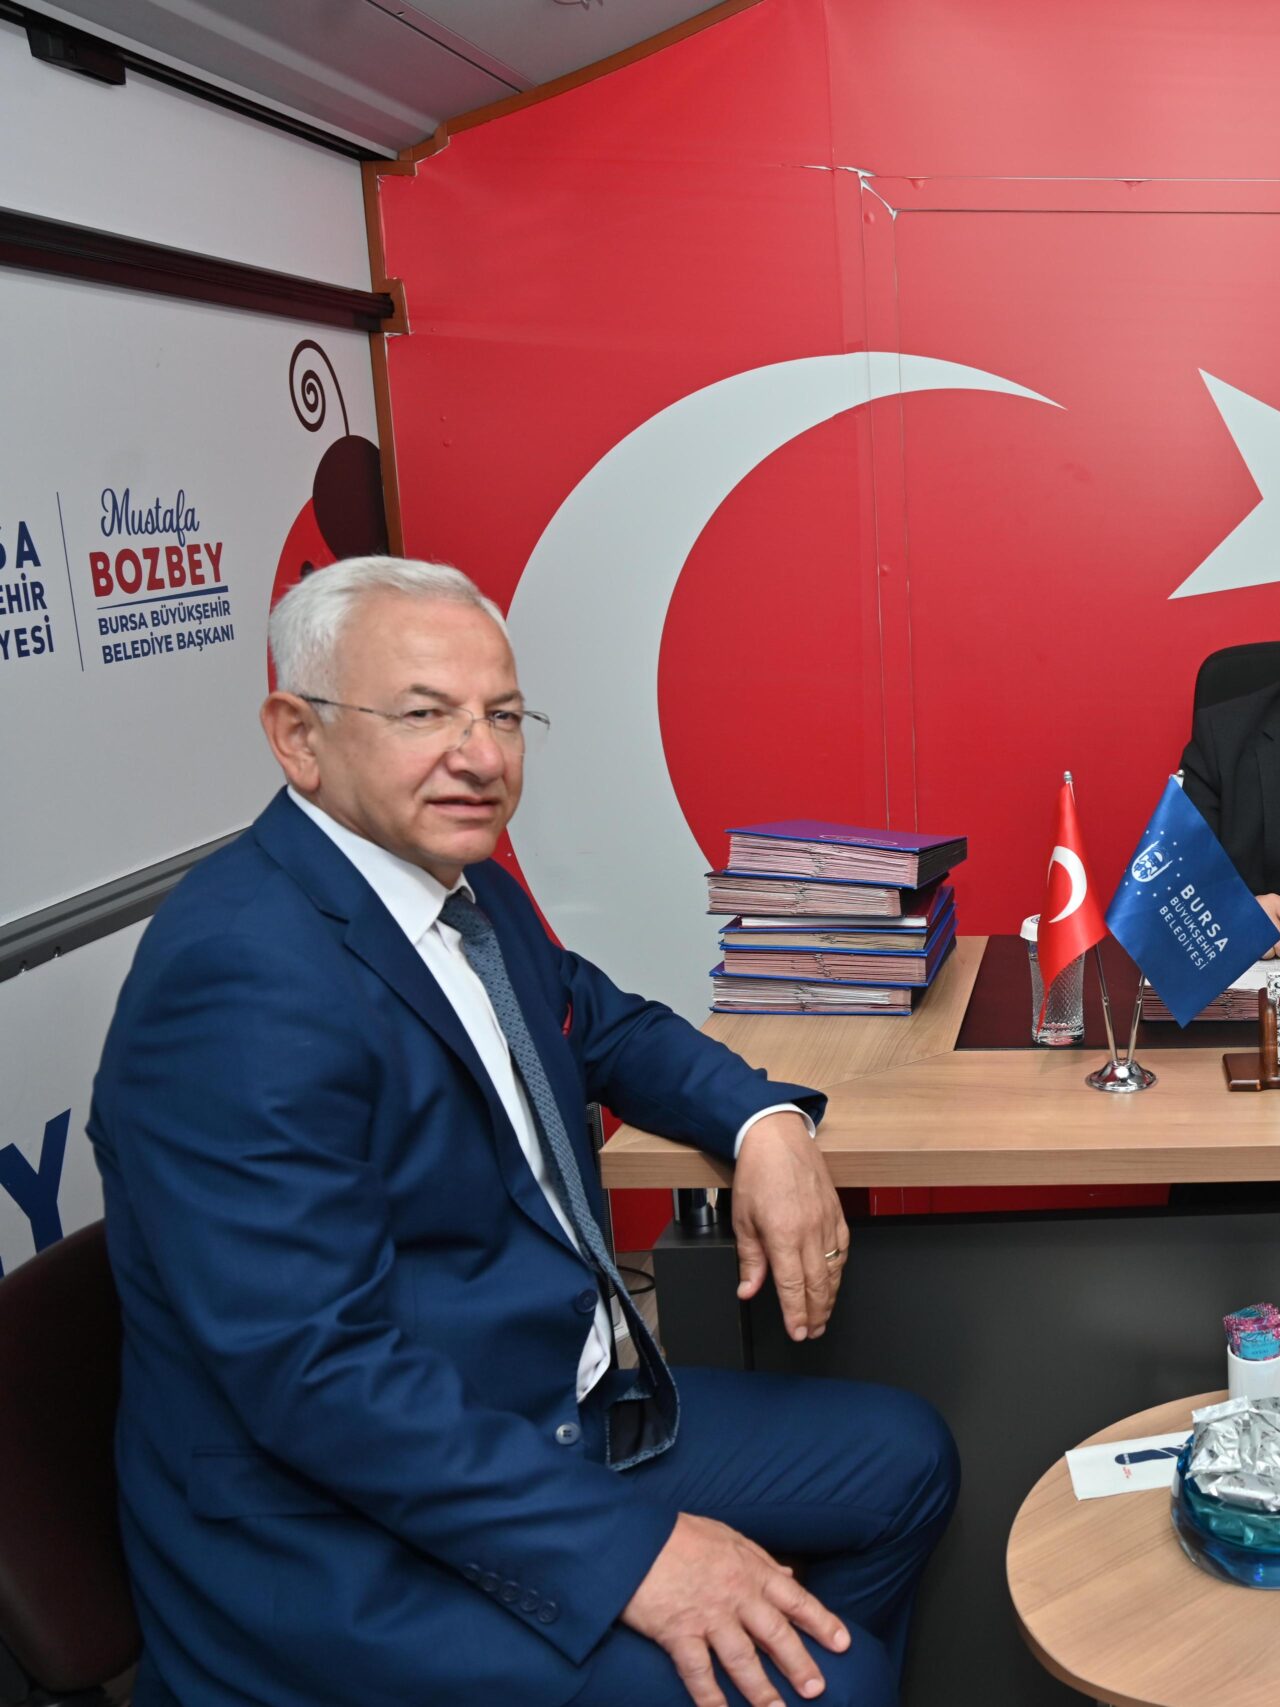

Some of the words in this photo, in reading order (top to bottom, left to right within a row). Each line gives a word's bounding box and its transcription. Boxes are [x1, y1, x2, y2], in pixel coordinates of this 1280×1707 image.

[101, 488, 200, 547] Mustafa
[89, 542, 223, 597] BOZBEY
[98, 612, 148, 636] BURSA
[150, 596, 231, 628] BÜYÜKŞEHİR
[102, 632, 174, 664] BELEDİYE
[177, 624, 234, 652] BAŞKANI
[1159, 905, 1209, 970] BELEDİYESİ
[1180, 884, 1229, 952] BURSA
